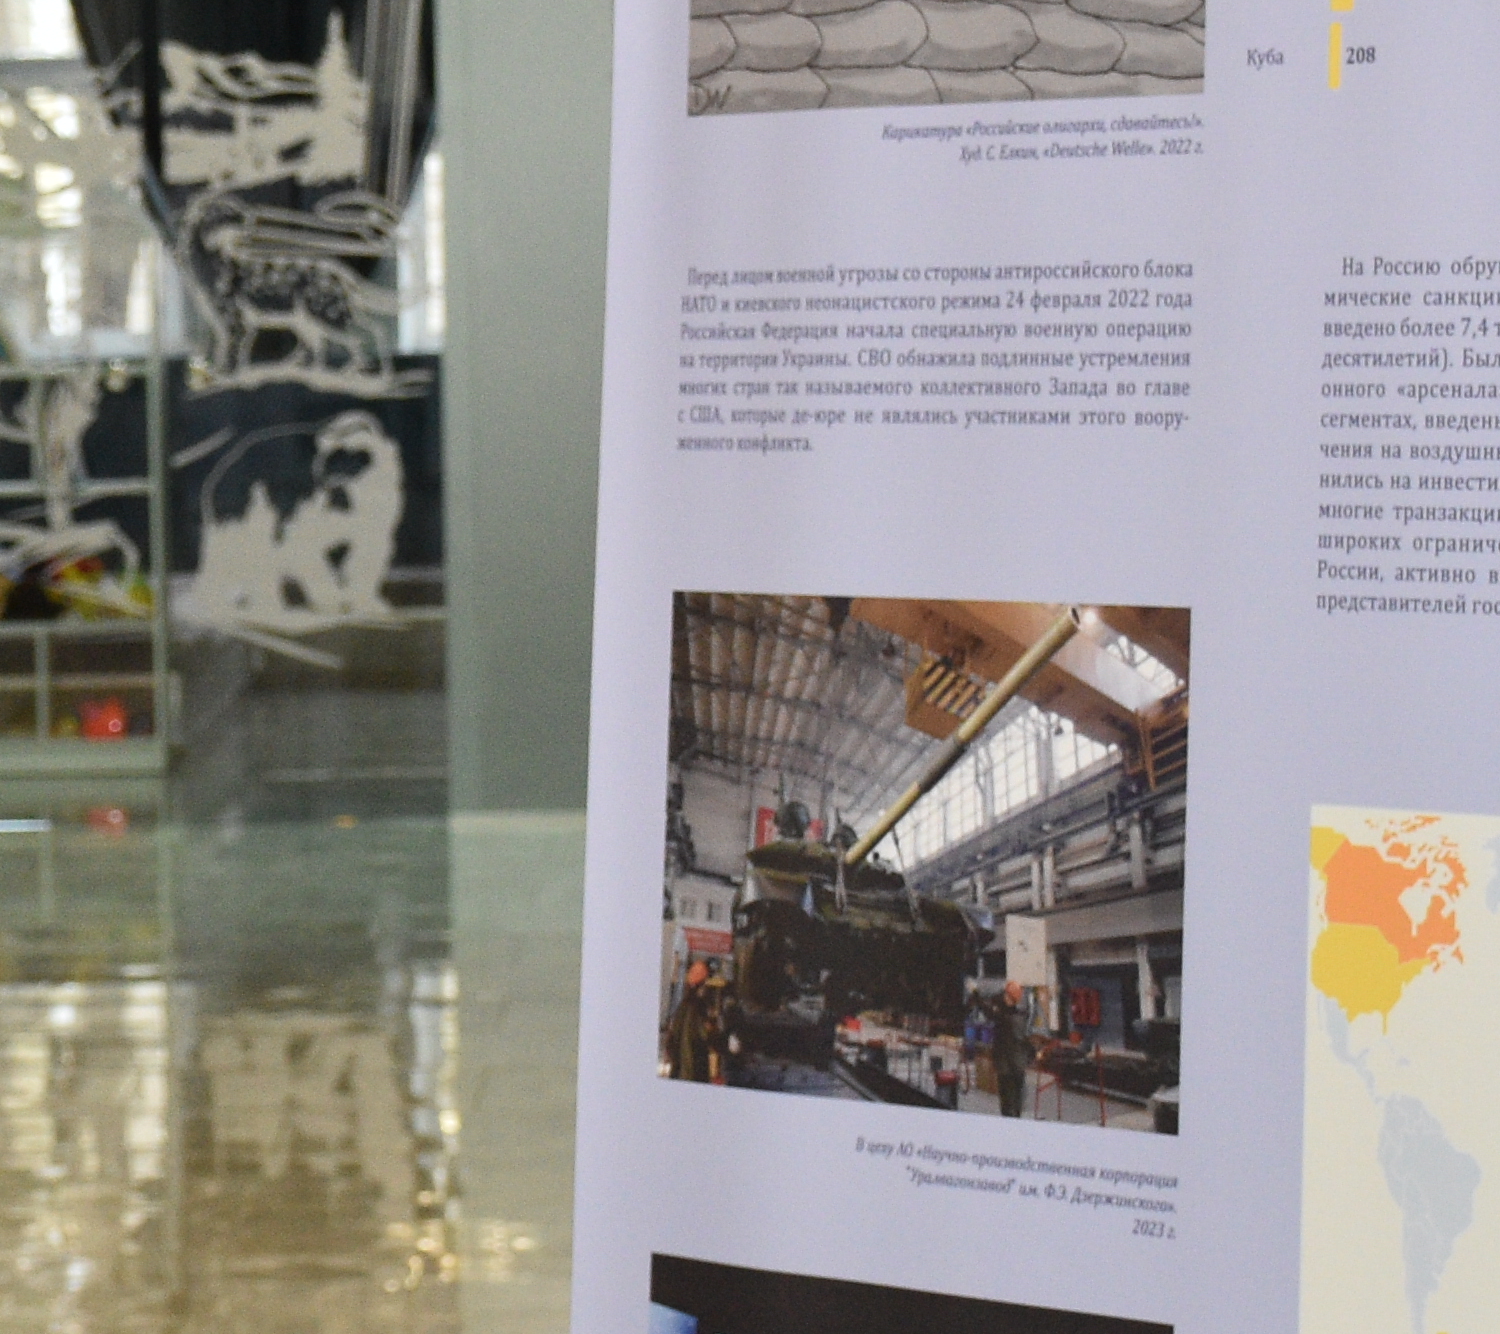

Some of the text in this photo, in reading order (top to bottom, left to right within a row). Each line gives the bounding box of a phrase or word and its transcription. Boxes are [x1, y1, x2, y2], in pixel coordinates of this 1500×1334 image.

[1246, 48, 1284, 71] Куба
[1345, 46, 1376, 65] 208
[1341, 255, 1365, 278] На
[1372, 254, 1442, 277] Россию
[1323, 290, 1413, 308] мические
